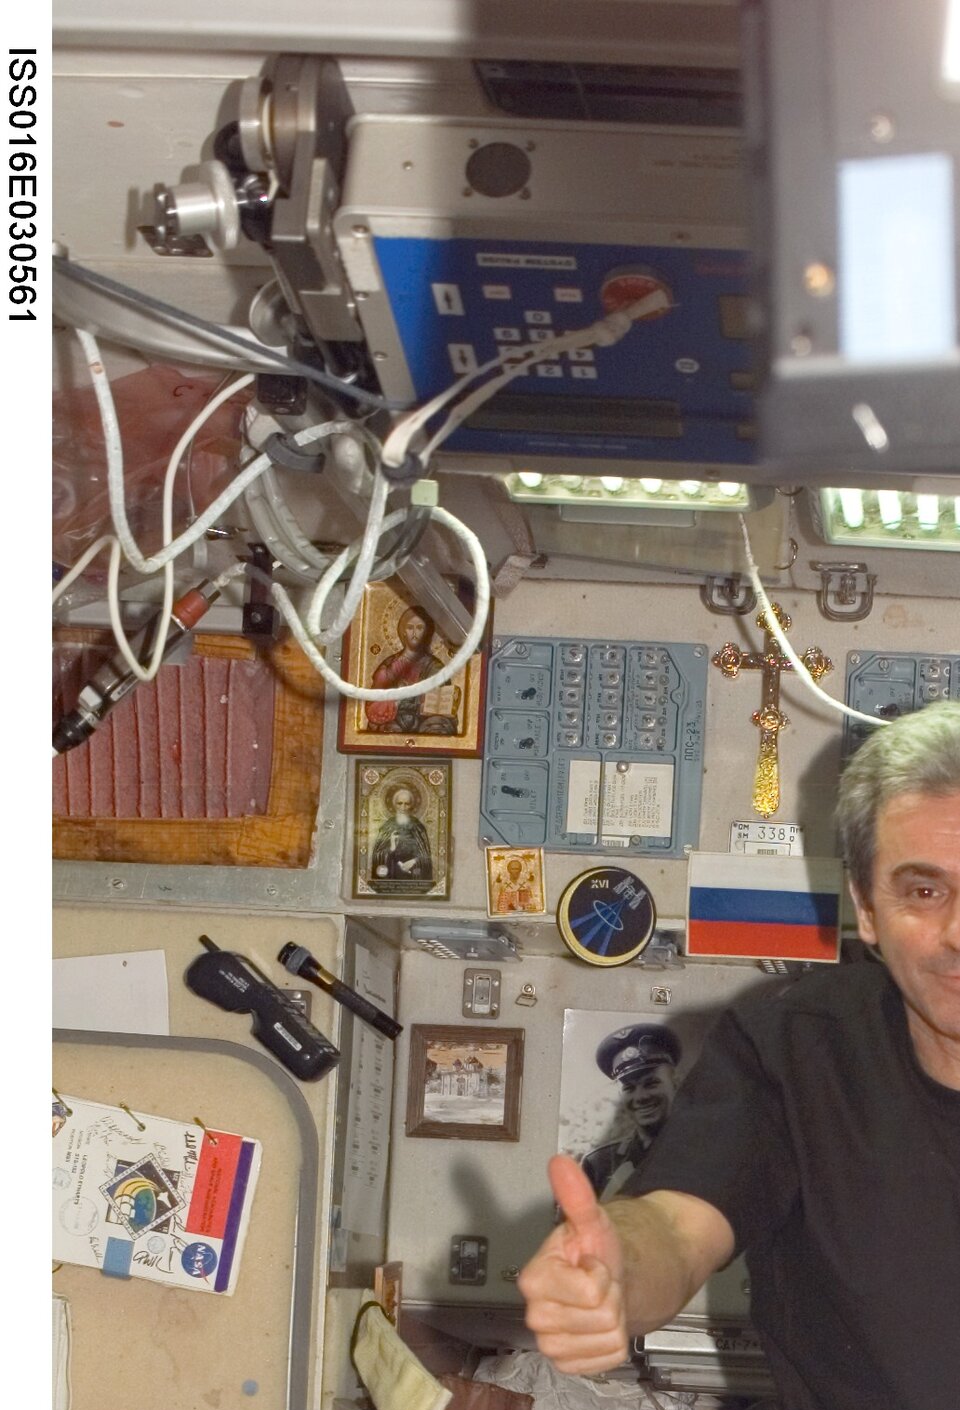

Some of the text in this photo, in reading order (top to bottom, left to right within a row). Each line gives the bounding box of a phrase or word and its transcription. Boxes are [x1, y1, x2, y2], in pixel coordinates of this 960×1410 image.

[757, 826, 786, 841] 338
[591, 879, 610, 889] XVI
[192, 1244, 207, 1276] NASA
